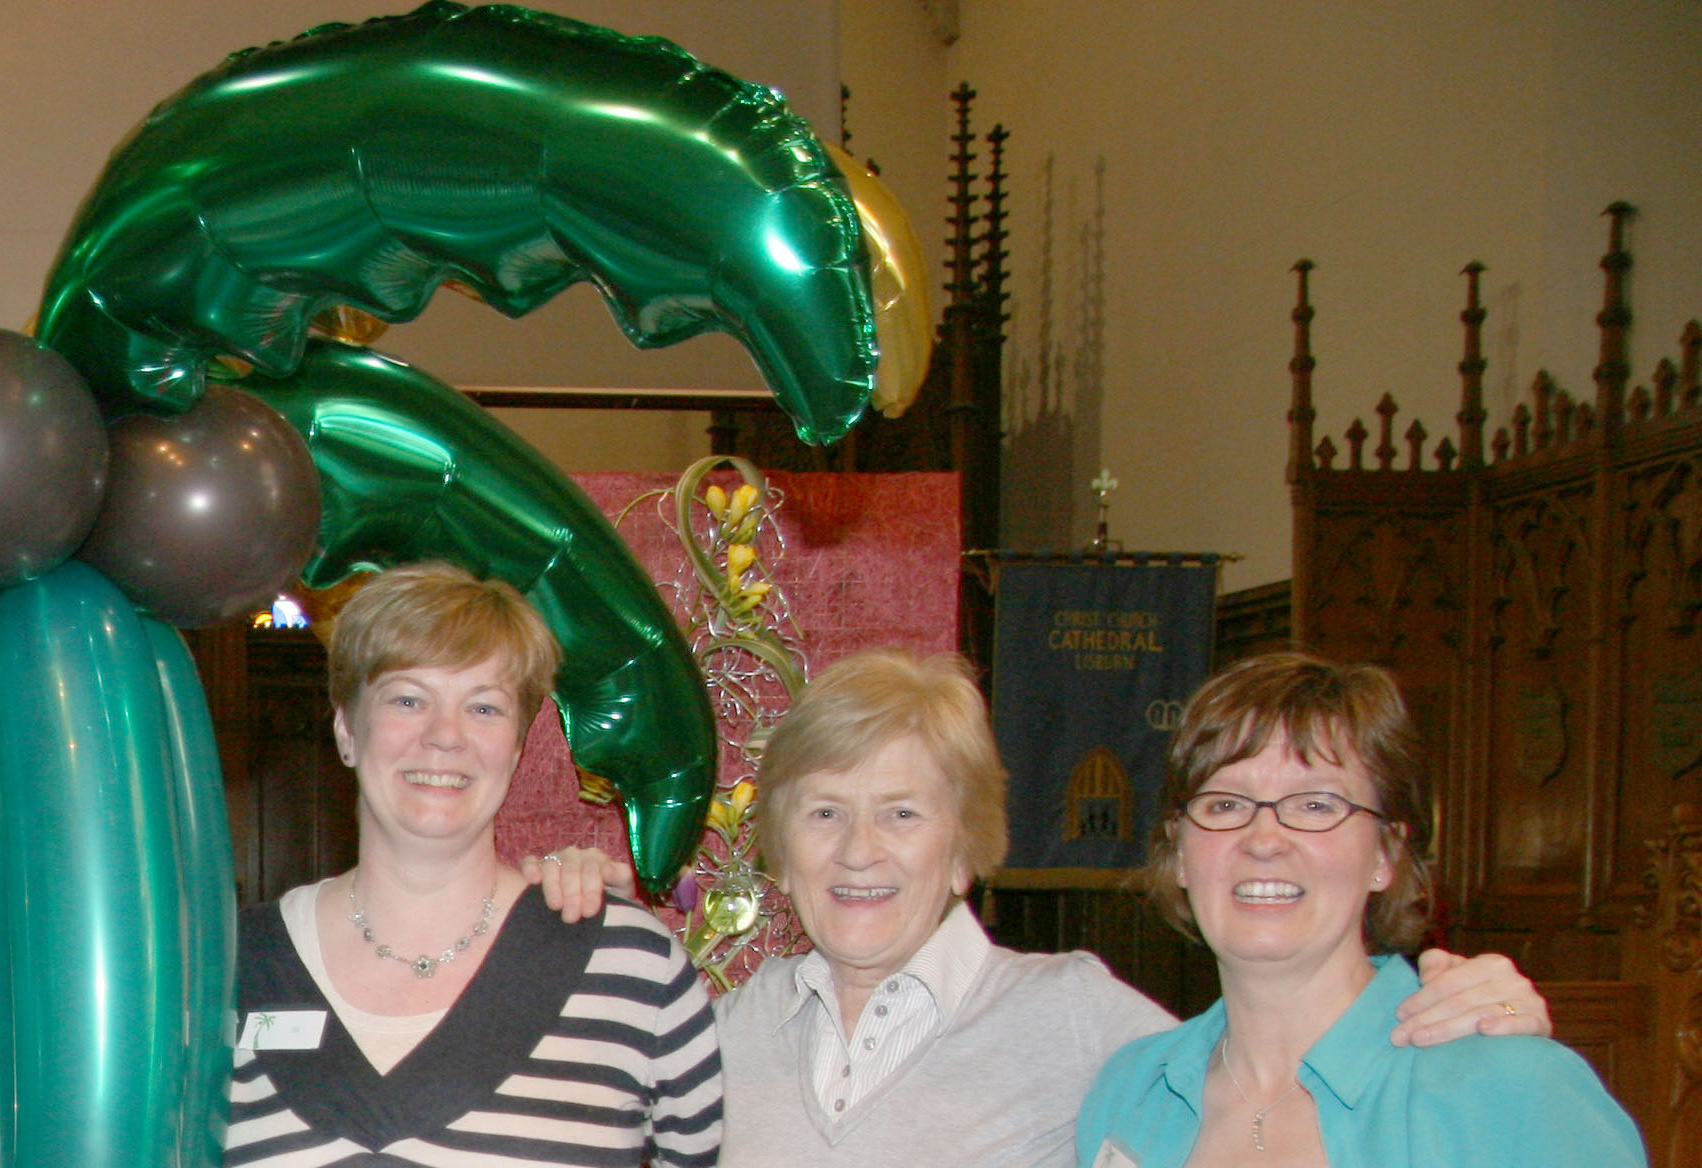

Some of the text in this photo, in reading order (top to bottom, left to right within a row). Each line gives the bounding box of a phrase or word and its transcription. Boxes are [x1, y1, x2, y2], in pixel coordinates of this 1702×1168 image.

[1054, 610, 1158, 627] CHRIST CHURCH
[1049, 629, 1164, 651] CATHEDRAL
